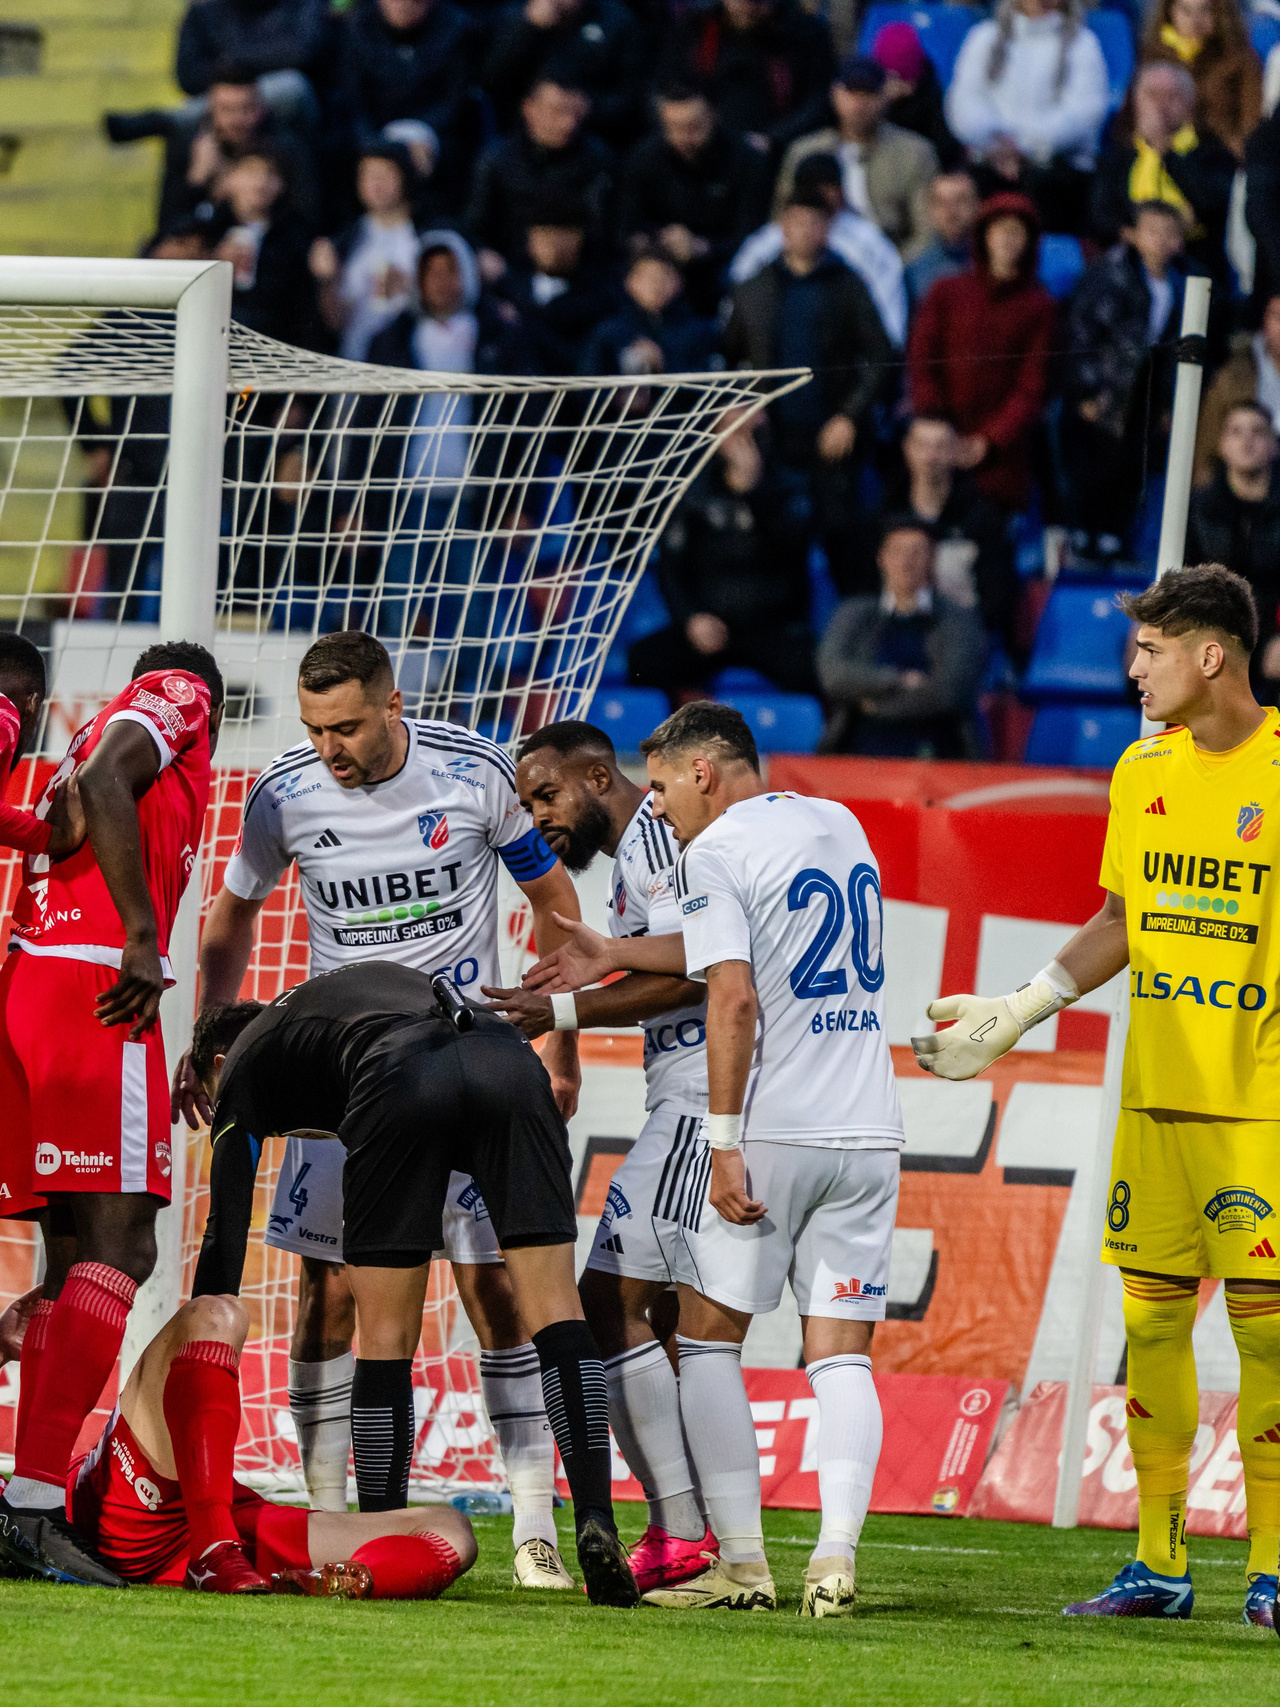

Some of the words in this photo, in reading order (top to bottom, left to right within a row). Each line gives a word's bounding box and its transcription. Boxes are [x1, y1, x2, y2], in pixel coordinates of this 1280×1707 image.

[1124, 749, 1173, 765] ELECTROALFA
[431, 768, 486, 791] ELECTROALFA
[271, 782, 323, 811] ELECTROALFA
[317, 861, 463, 909] UNIBET
[1143, 851, 1271, 895] UNIBET
[338, 925, 401, 945] ÎMPREUNĂ
[402, 922, 436, 942] SPRE
[436, 915, 457, 933] 0%
[787, 863, 885, 1000] 20
[1146, 913, 1196, 934] ÎMPREUNĂ
[1199, 922, 1228, 939] SPRE
[1229, 926, 1249, 941] 0%
[812, 1010, 881, 1035] BENZAR
[62, 1150, 114, 1167] Tehnic
[289, 1162, 313, 1217] 4
[1106, 1180, 1131, 1232] 8
[1206, 1200, 1221, 1218] FIVE
[1220, 1193, 1269, 1217] CONTINENTS
[298, 1226, 338, 1246] Vestra
[1104, 1237, 1138, 1253] Vestra
